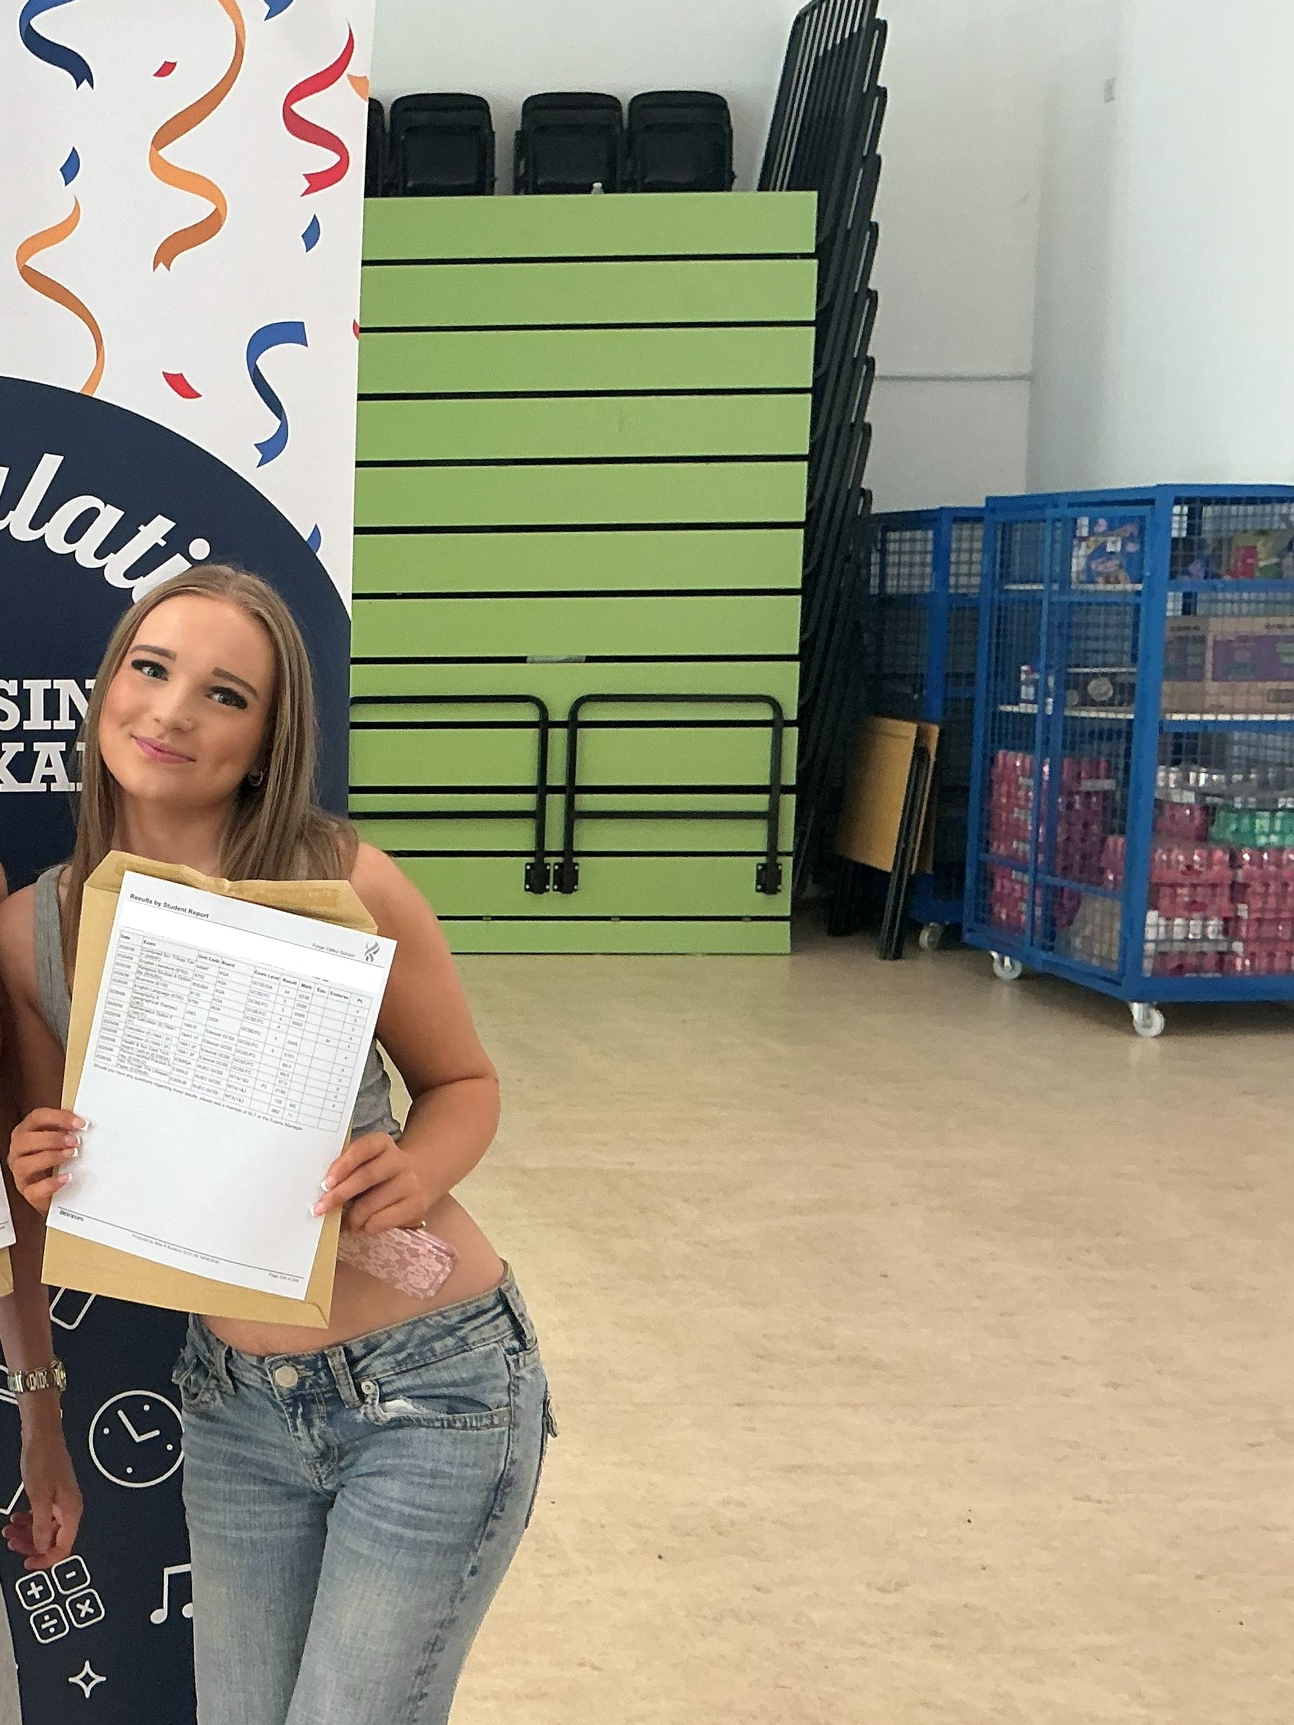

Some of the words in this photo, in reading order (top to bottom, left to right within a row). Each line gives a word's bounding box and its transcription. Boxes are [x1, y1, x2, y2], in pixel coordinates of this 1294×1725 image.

[129, 893, 153, 904] Results
[162, 901, 187, 913] Student
[187, 908, 209, 919] Report
